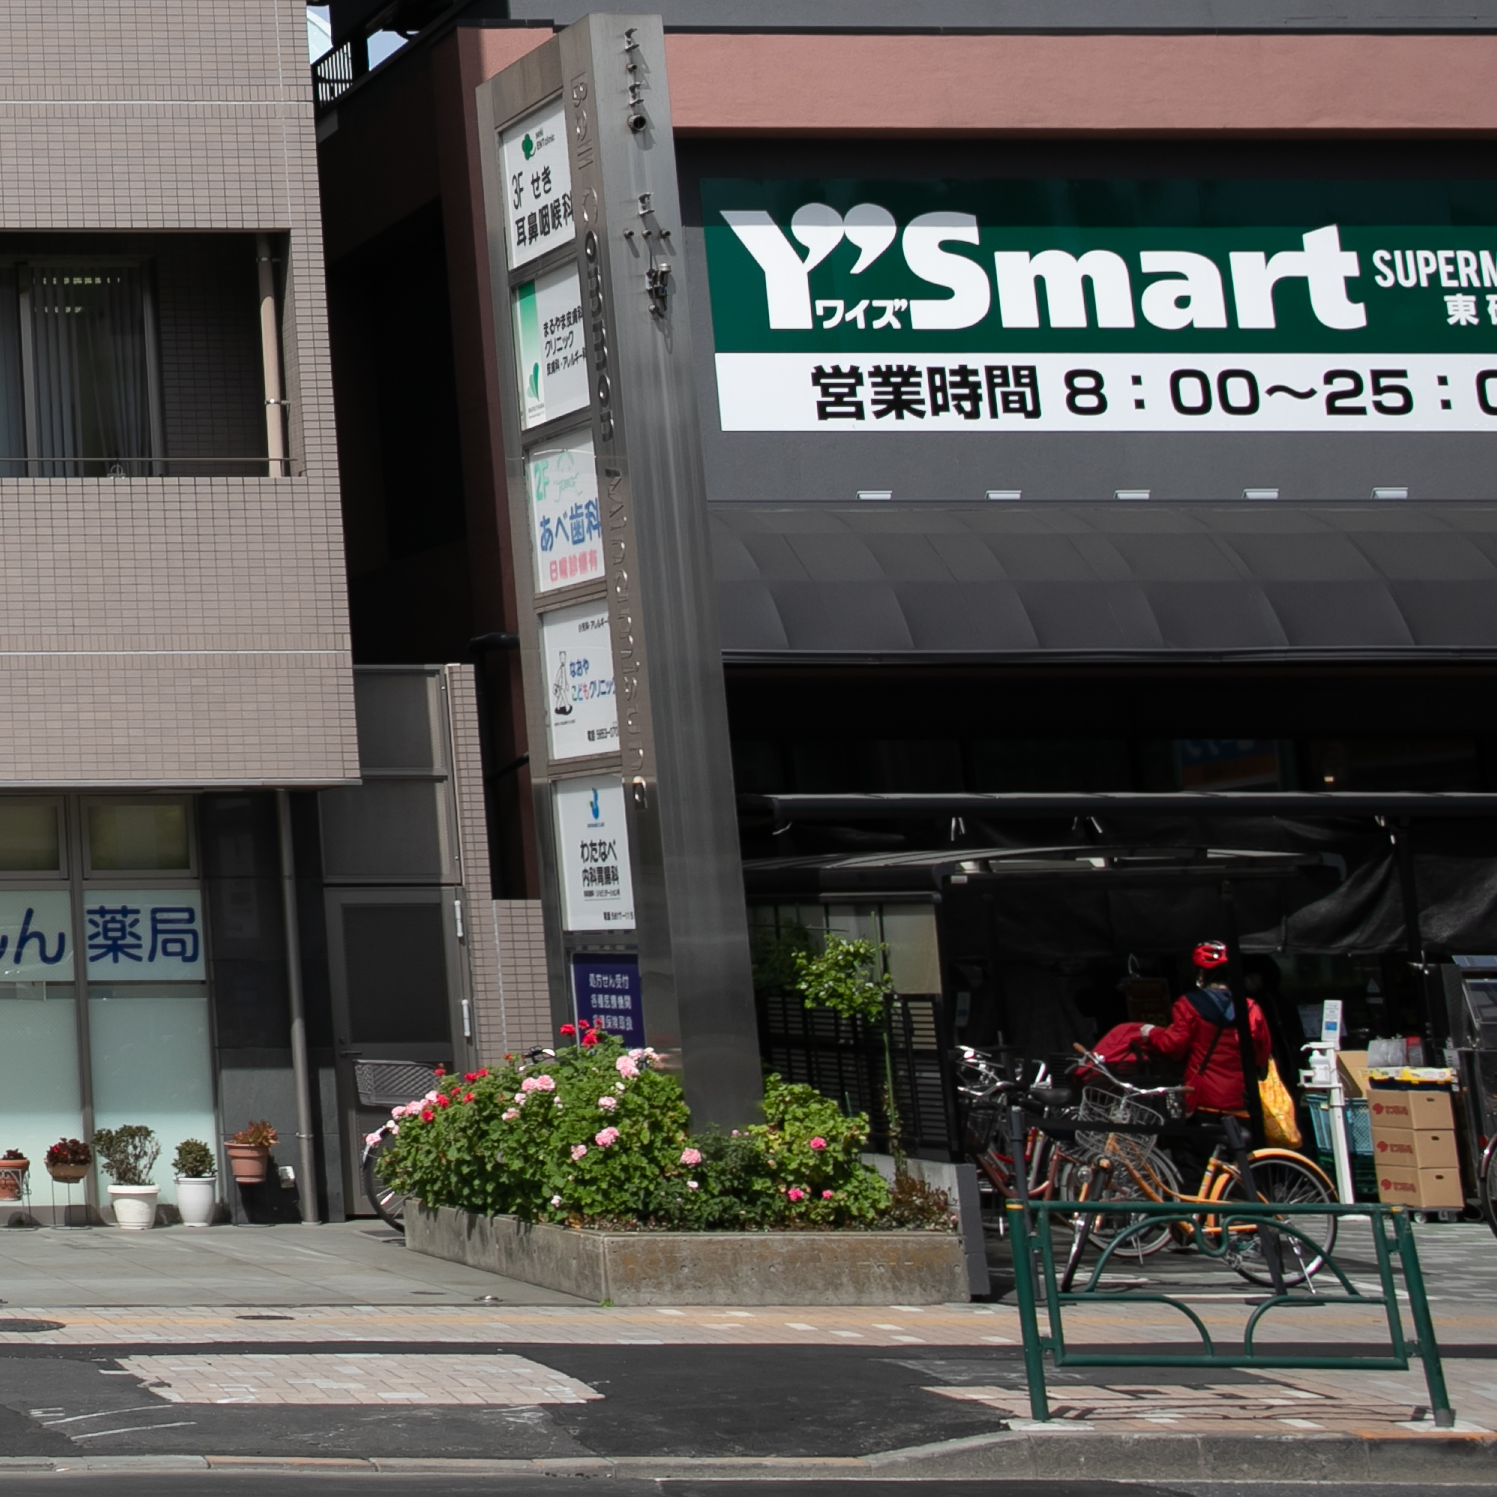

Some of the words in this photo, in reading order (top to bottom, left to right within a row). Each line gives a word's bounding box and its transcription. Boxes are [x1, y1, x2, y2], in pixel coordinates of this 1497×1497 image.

[512, 171, 524, 210] 3F
[531, 165, 552, 199] せき
[515, 191, 573, 246] 耳鼻咽喉科
[545, 330, 574, 357] クリニック
[811, 365, 1042, 420] 営業時間
[534, 460, 549, 501] 2F
[540, 497, 601, 552] あべ歯科
[569, 658, 590, 677] なおや
[572, 679, 616, 701] こどもクリニッ
[580, 839, 618, 863] わたなべ
[582, 865, 620, 887] 内科胃腸科
